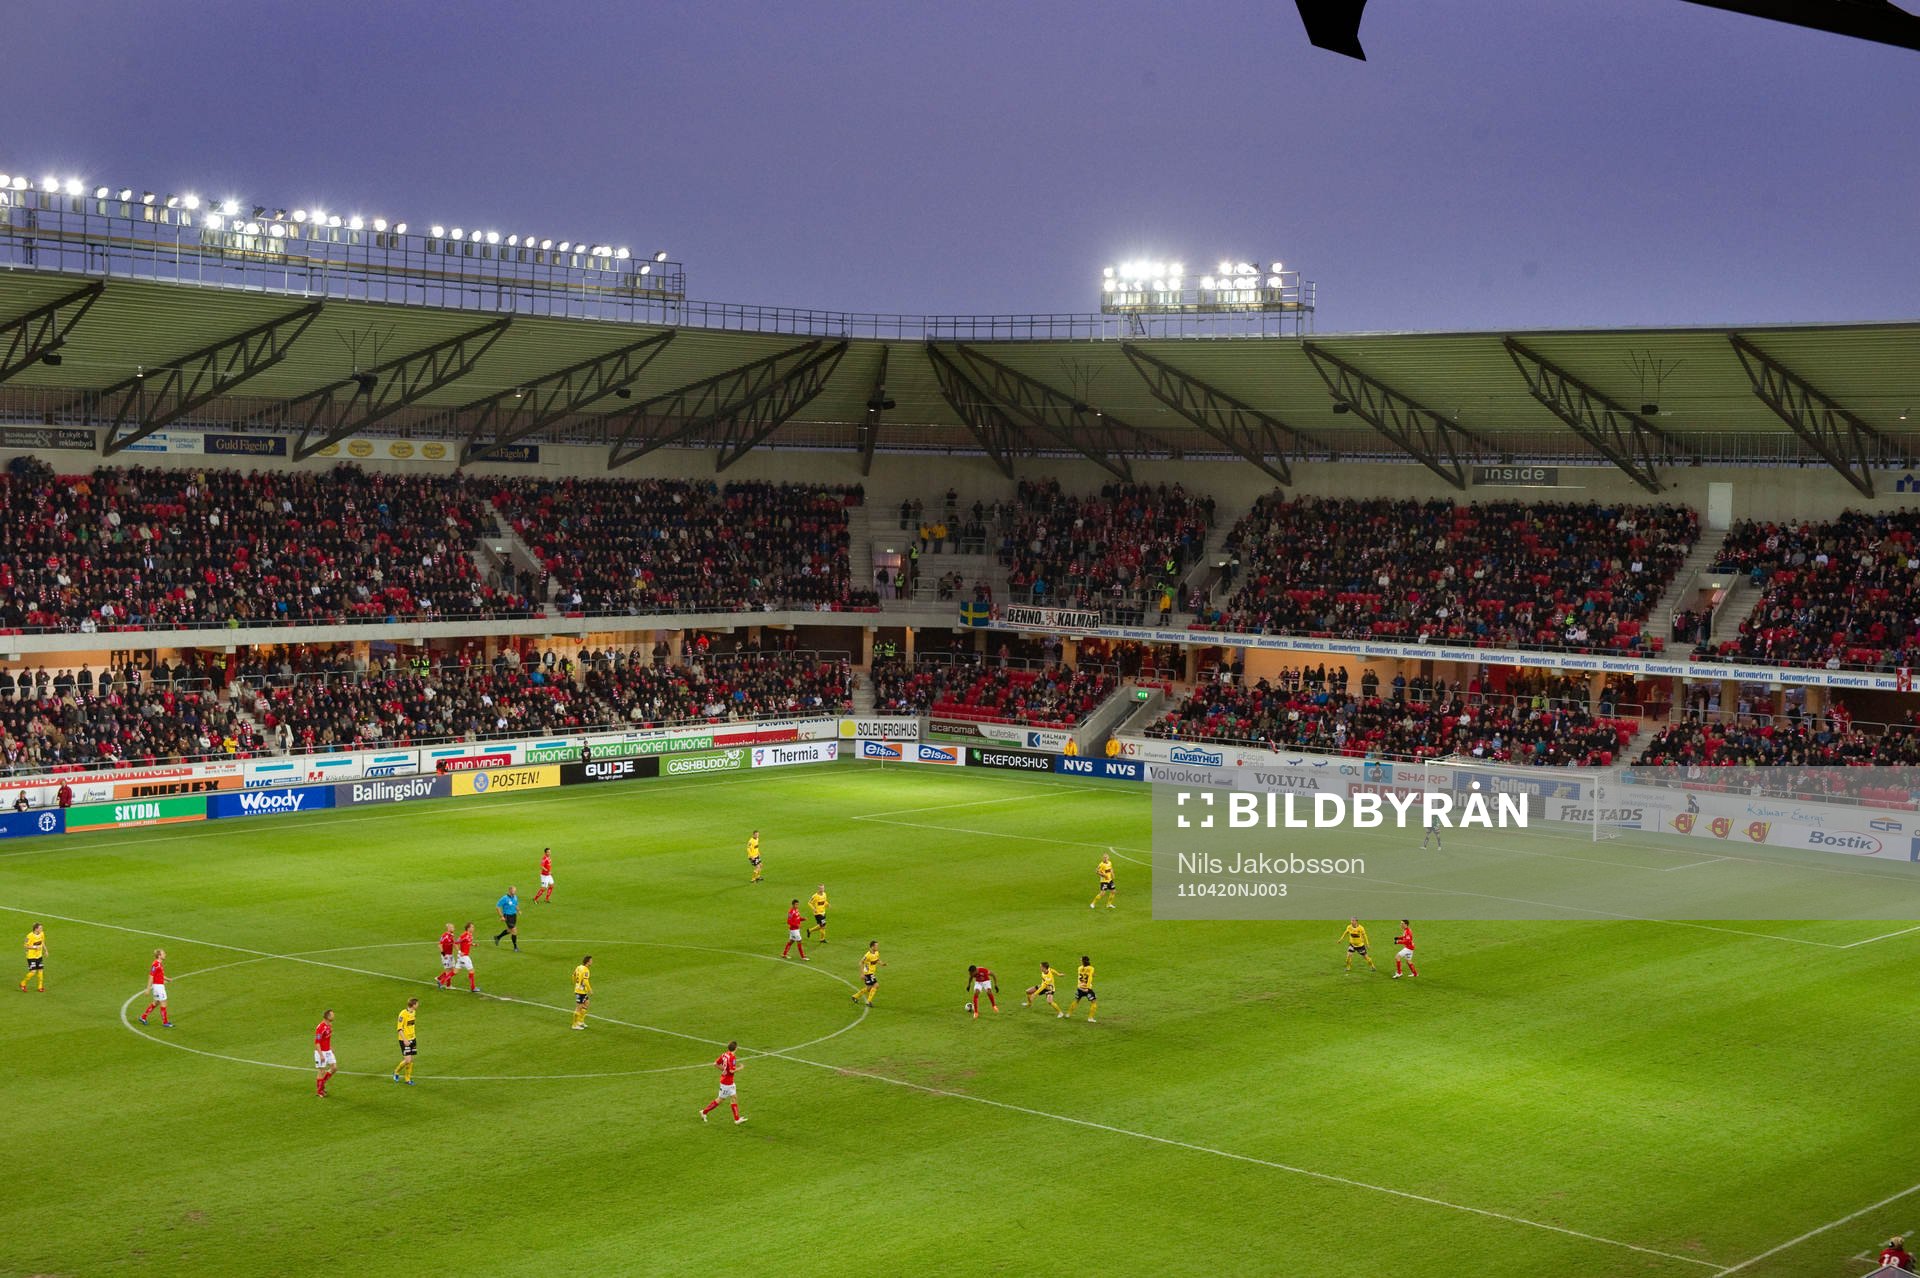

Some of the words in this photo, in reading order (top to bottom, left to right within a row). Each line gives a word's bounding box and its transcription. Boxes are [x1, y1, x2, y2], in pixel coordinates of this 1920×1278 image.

[216, 439, 239, 450] Guld
[1485, 467, 1545, 480] inside
[1008, 609, 1041, 625] BENNO
[1057, 612, 1099, 628] KALMAR
[1292, 641, 1324, 650] Barometern
[1328, 643, 1360, 652] Barometern
[1365, 645, 1397, 655] Barometern
[1402, 647, 1435, 657] Barometern
[1441, 650, 1474, 660] Barometern
[1480, 652, 1514, 663] Barometern
[1520, 655, 1555, 665] Barometern
[1561, 658, 1597, 668] Barometern
[1602, 660, 1639, 671] Barometern
[1645, 663, 1683, 674] Barometern
[1689, 666, 1727, 677] Barometern
[1733, 669, 1773, 680] Barometern
[1780, 672, 1820, 684] Barometern
[1827, 675, 1868, 687] Barometern
[857, 722, 917, 737] SOLENERGIHUS
[931, 724, 976, 735] scanomat
[772, 746, 818, 763] Thermia
[983, 753, 1048, 769] EKEFORSHUS
[585, 761, 635, 776] GUIDE
[1064, 759, 1093, 772] NVS
[1106, 764, 1136, 776] NVS
[491, 772, 539, 788] POSTEN!
[1150, 766, 1212, 784] Volvokort
[1254, 772, 1320, 790] VOLVIA
[1398, 771, 1447, 784] SHARP
[353, 780, 432, 802] Ballingslöv
[239, 790, 304, 812] Woody
[115, 803, 160, 821] SKYDDA
[1561, 804, 1643, 821] FRISTADS
[1808, 831, 1873, 849] Bostik
